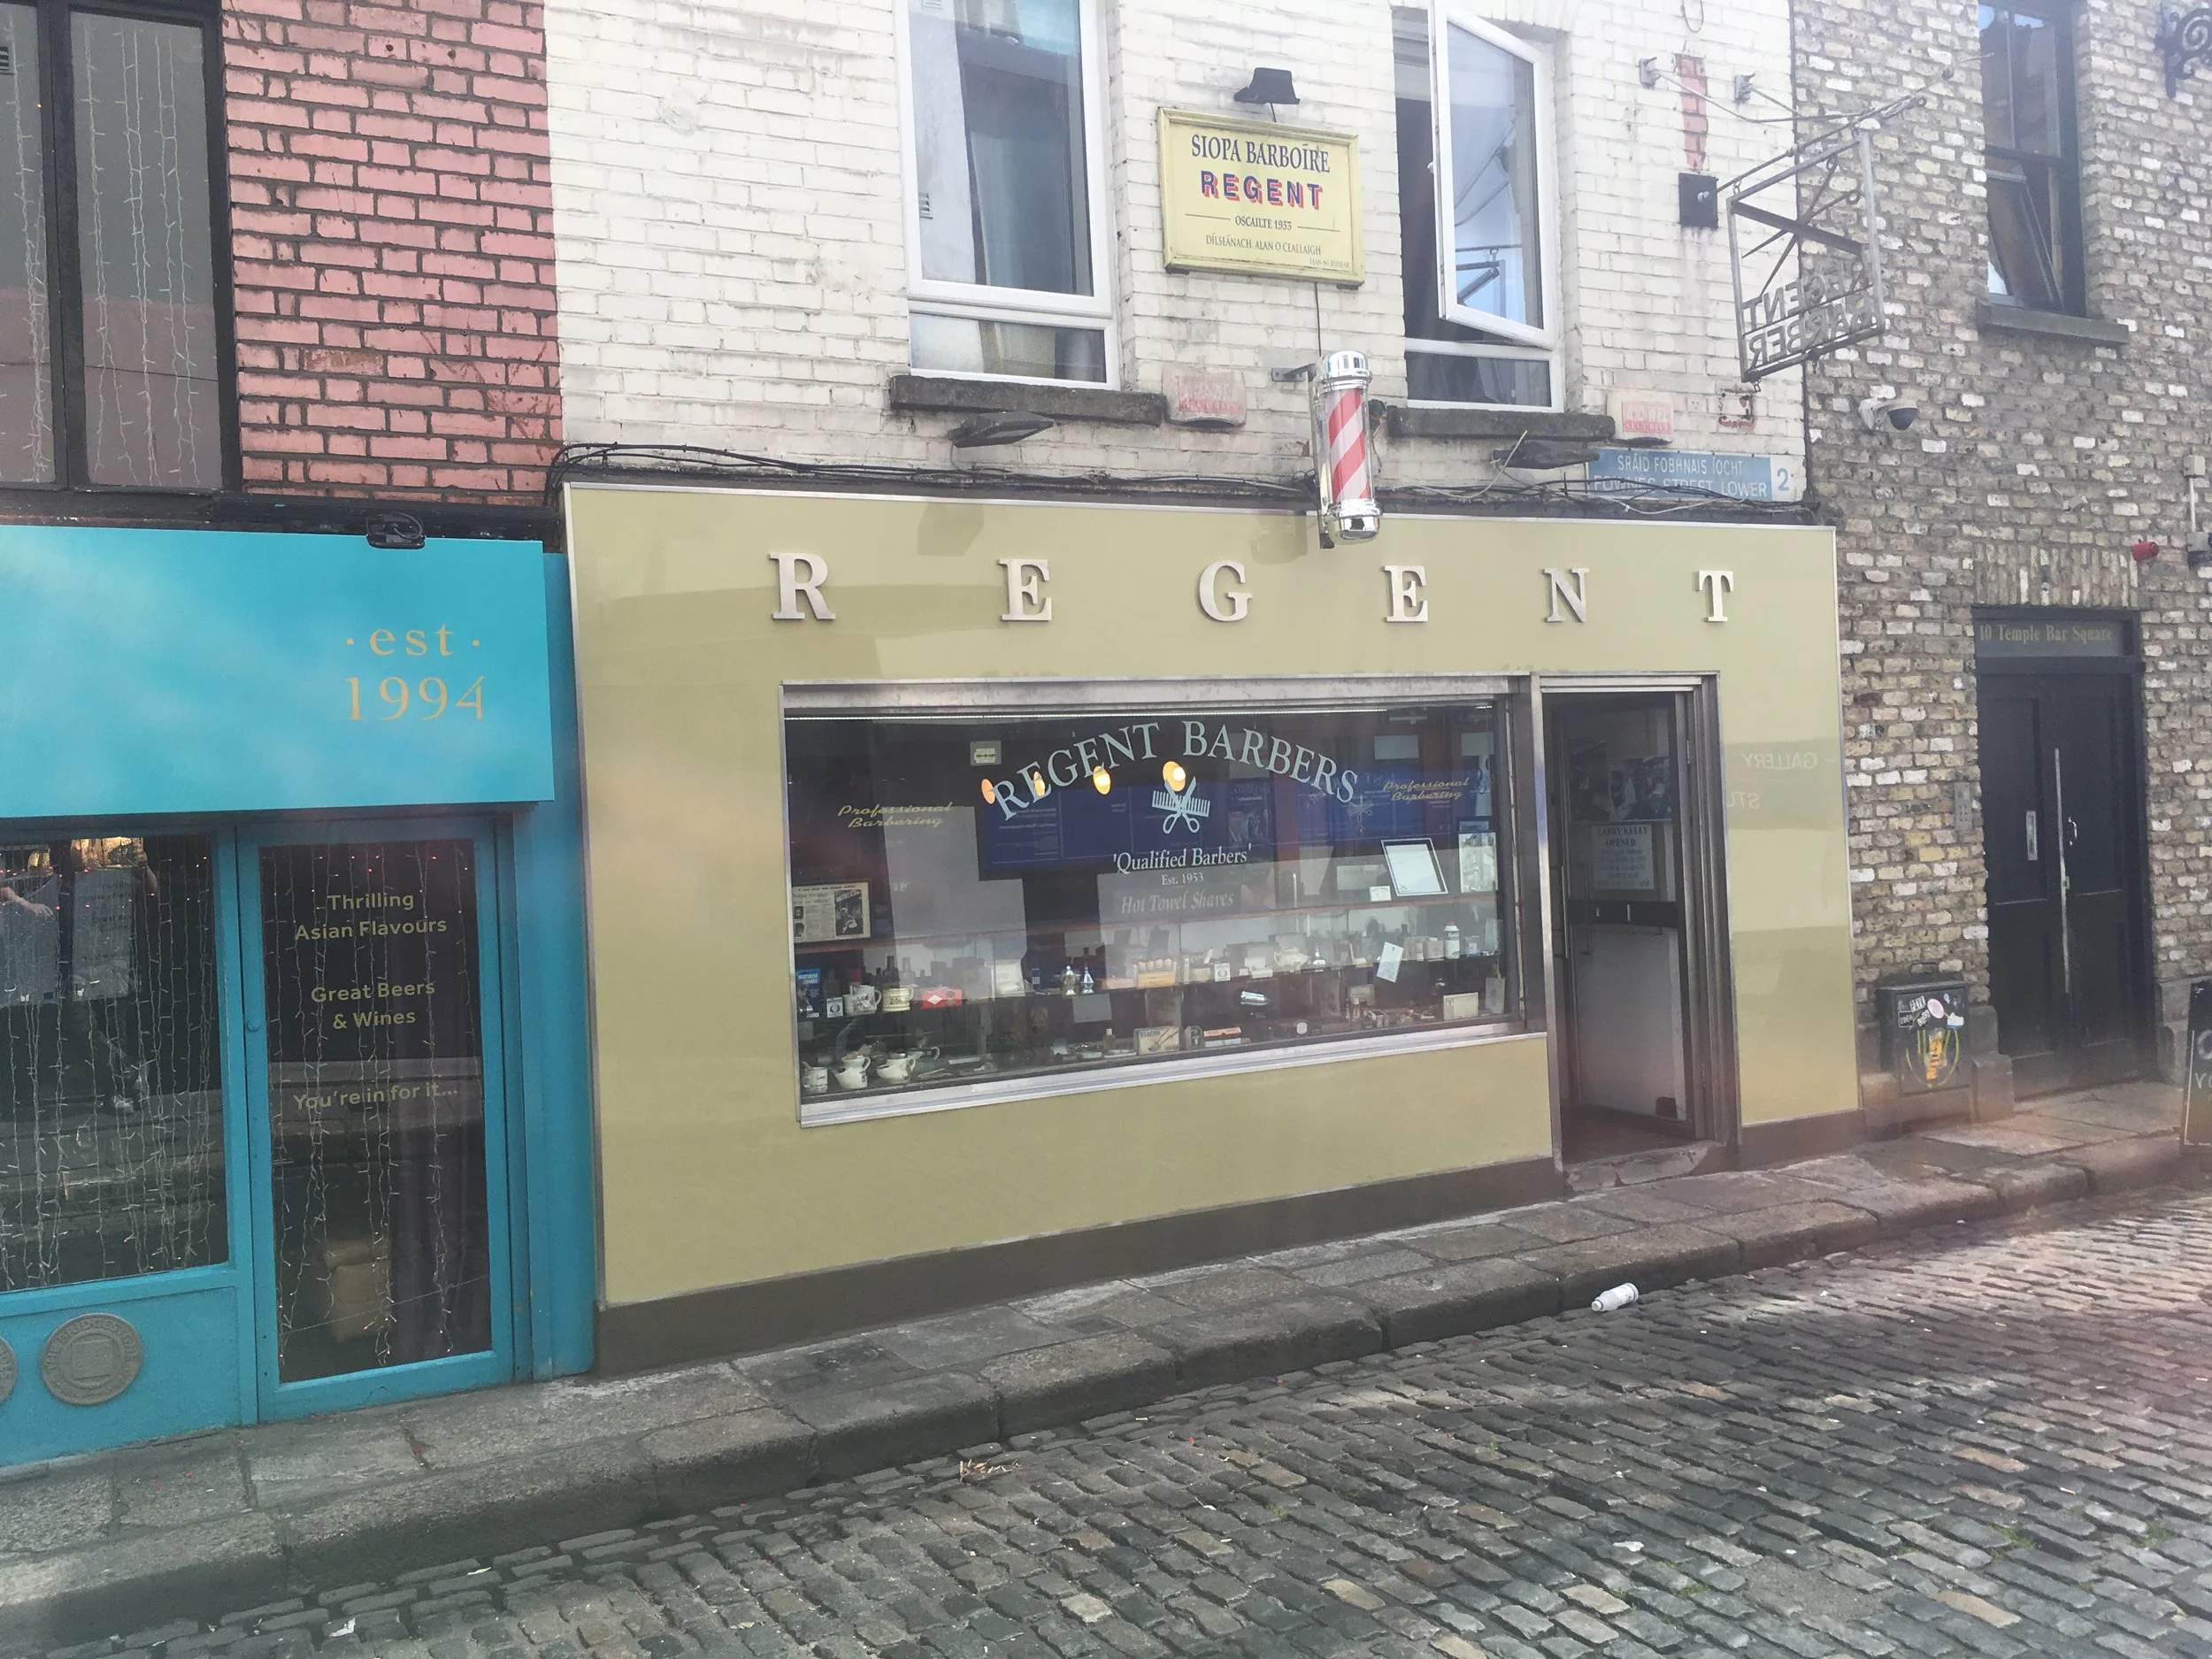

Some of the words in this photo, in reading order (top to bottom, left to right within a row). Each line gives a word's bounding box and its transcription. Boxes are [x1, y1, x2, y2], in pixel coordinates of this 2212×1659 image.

[1192, 134, 1241, 163] SIOPA
[1201, 170, 1323, 211] REGENT
[1234, 215, 1272, 229] OSCAILTE
[1274, 219, 1292, 231] 1953
[1255, 240, 1274, 251] ALAN
[1282, 242, 1321, 256] CEALLAIGH
[1617, 454, 1650, 472] SRÁID
[1654, 457, 1708, 475] FOBHNAIS
[1777, 468, 1790, 492] 2
[1721, 480, 1768, 498] LOWER
[769, 552, 1734, 622] REGENT
[1979, 624, 1991, 641] 10
[1996, 624, 2040, 643] Temple
[2046, 625, 2068, 641] Bar
[2072, 626, 2113, 644] Square
[345, 676, 485, 721] 1994
[992, 722, 1159, 820] REGENT
[1182, 720, 1358, 803] BARBERS
[1383, 777, 1470, 791] Professional
[1390, 791, 1463, 802] Barbering
[838, 802, 954, 817] Professional
[849, 817, 945, 828] Barbering
[1162, 874, 1179, 886] Est.
[1181, 872, 1204, 884] 1953
[328, 893, 414, 911] Thrilling
[1121, 895, 1146, 914] Hot
[1149, 889, 1187, 912] Towel
[1191, 888, 1234, 909] Shaves
[295, 924, 353, 941] Asian
[359, 919, 447, 936] Flavours
[311, 985, 372, 1004] Great
[378, 980, 435, 999] Beers
[333, 1013, 348, 1029] &
[354, 1010, 416, 1028] Wines
[293, 1091, 361, 1110] You're
[367, 1088, 385, 1103] in
[390, 1085, 420, 1100] for
